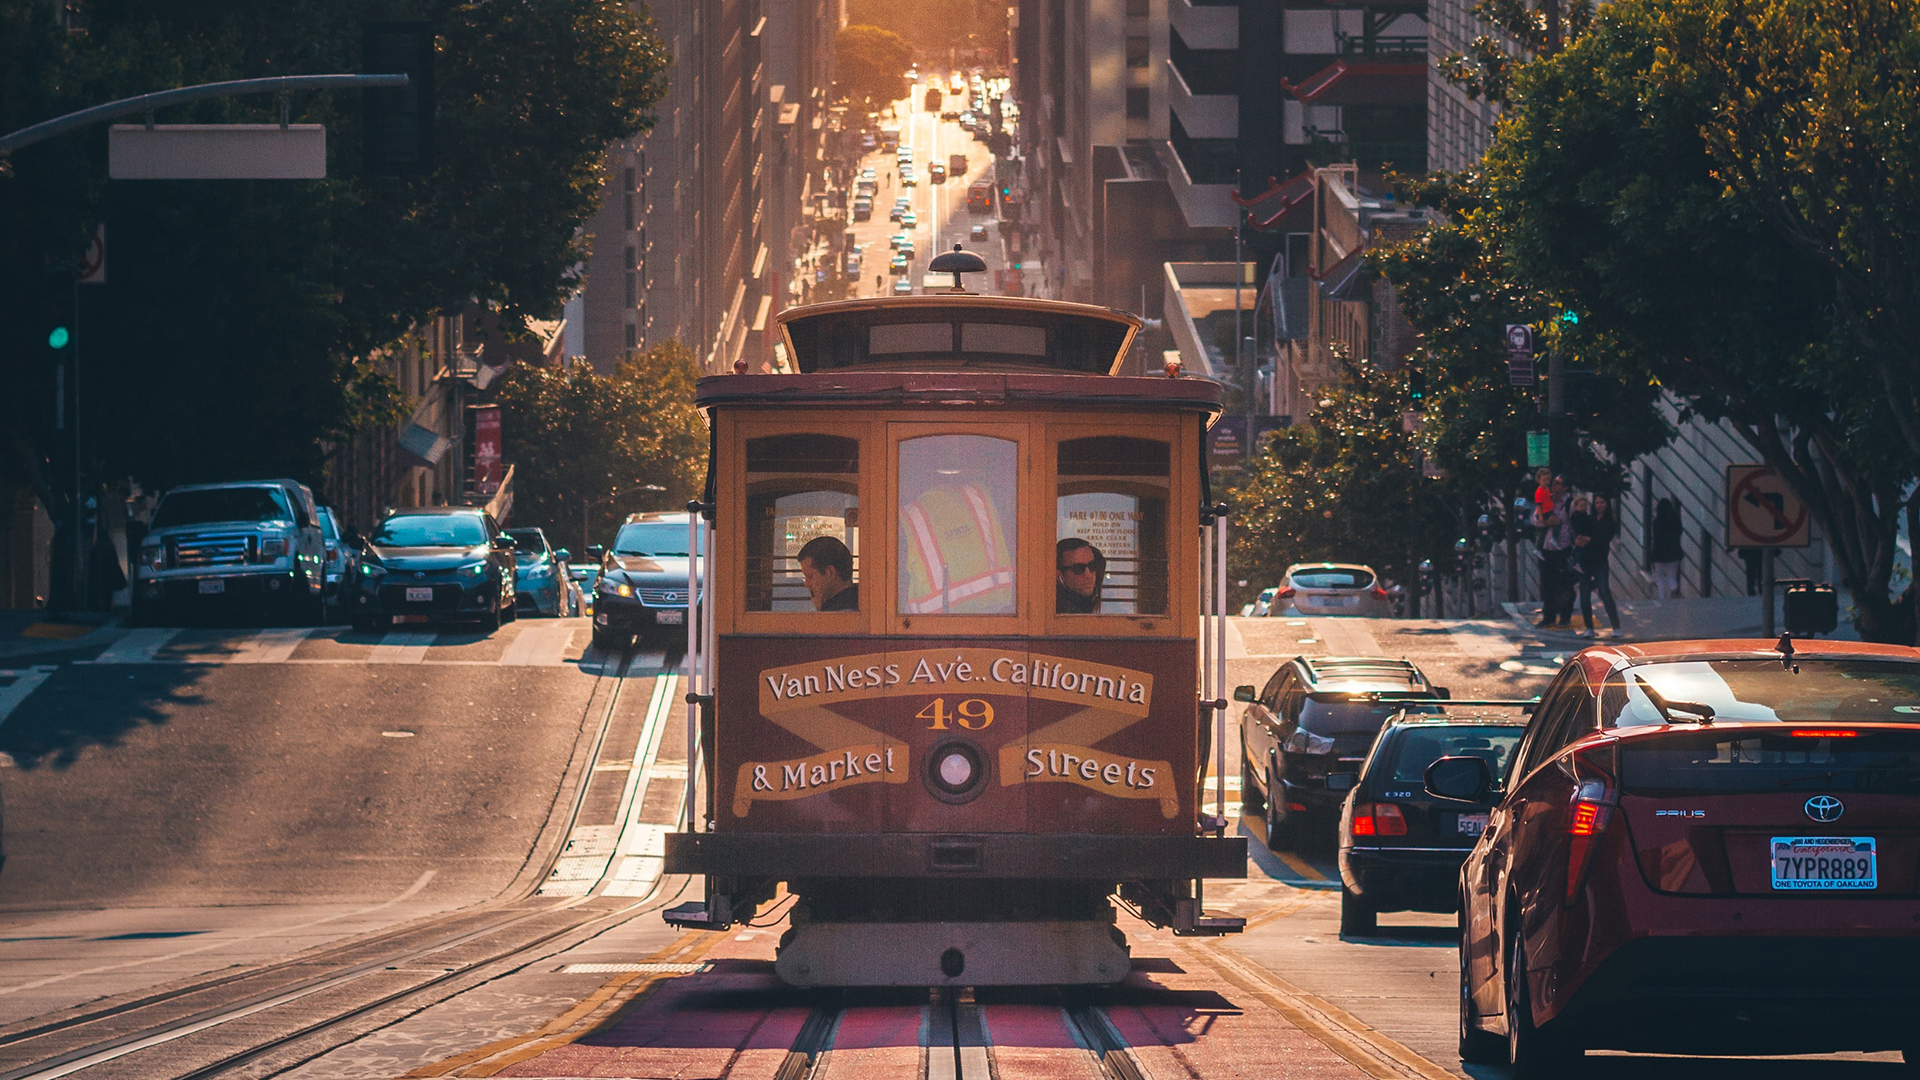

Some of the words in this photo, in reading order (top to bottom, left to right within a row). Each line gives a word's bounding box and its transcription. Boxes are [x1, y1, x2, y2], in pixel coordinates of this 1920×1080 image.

[1069, 511, 1087, 520] FARE
[1109, 511, 1125, 520] ONE
[767, 673, 821, 700] Van
[824, 664, 900, 691] Ness
[991, 657, 1146, 704] California
[915, 697, 995, 730] 49
[752, 765, 774, 791] &
[782, 747, 895, 789] Market
[1026, 749, 1156, 788] Streets
[1656, 810, 1705, 818] PRIUS
[1793, 845, 1856, 857] California
[1778, 857, 1869, 879] 7YPR889
[1775, 880, 1791, 888] ONE
[1793, 880, 1822, 888] TOYOTA
[1824, 880, 1835, 888] OF
[1836, 880, 1875, 888] OAKLAND
